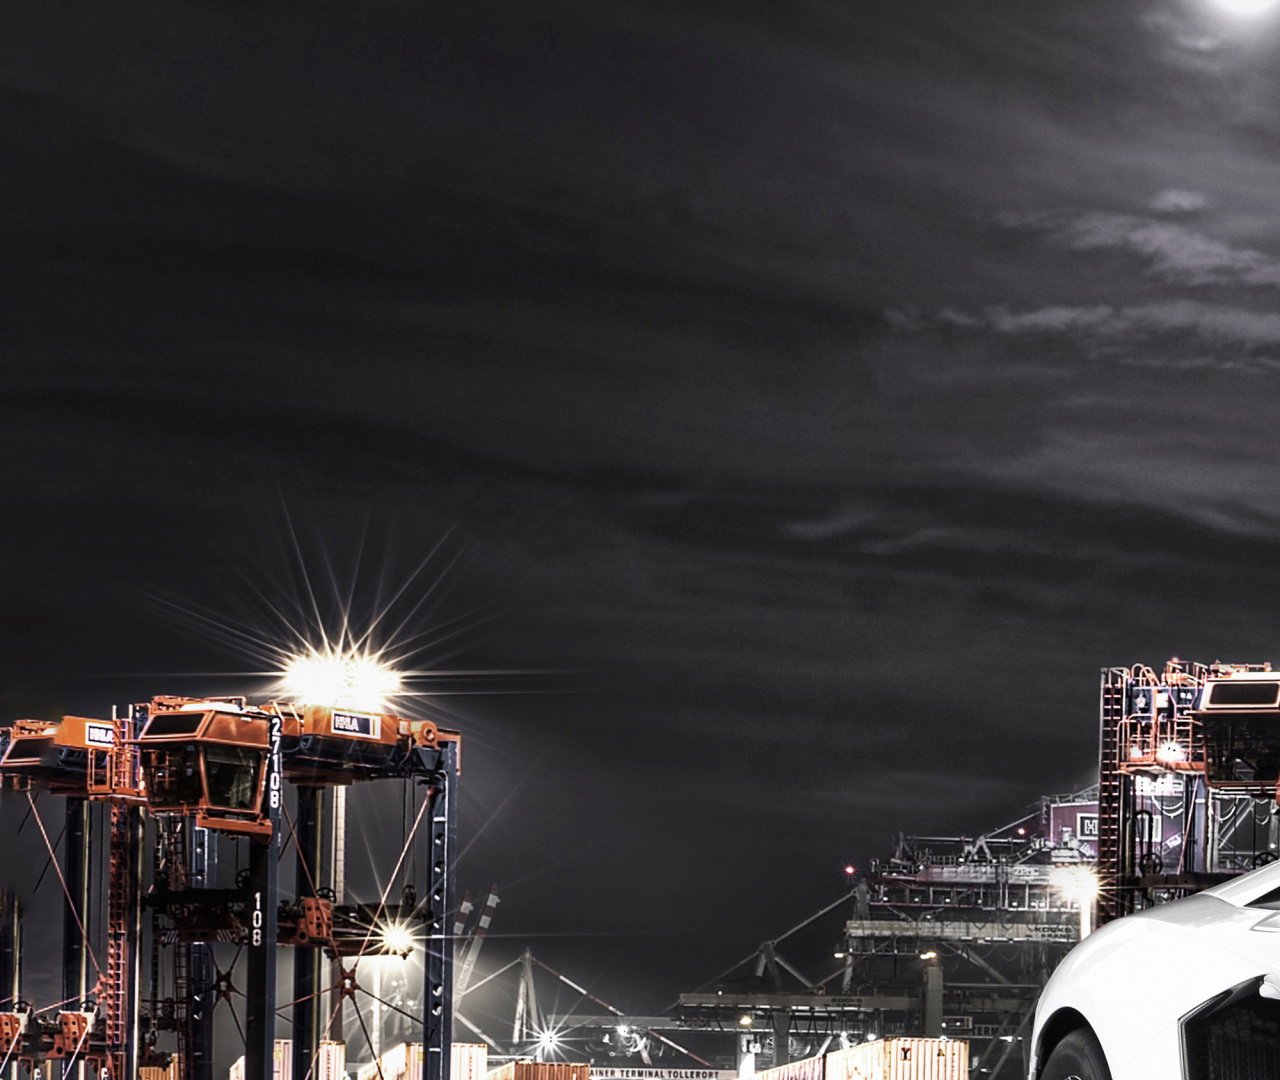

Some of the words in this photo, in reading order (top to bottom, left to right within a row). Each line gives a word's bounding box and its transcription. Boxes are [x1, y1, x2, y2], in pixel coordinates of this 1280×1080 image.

[253, 892, 262, 946] 108
[620, 1070, 665, 1078] TERMINAL
[668, 1070, 720, 1079] TOLLERORT
